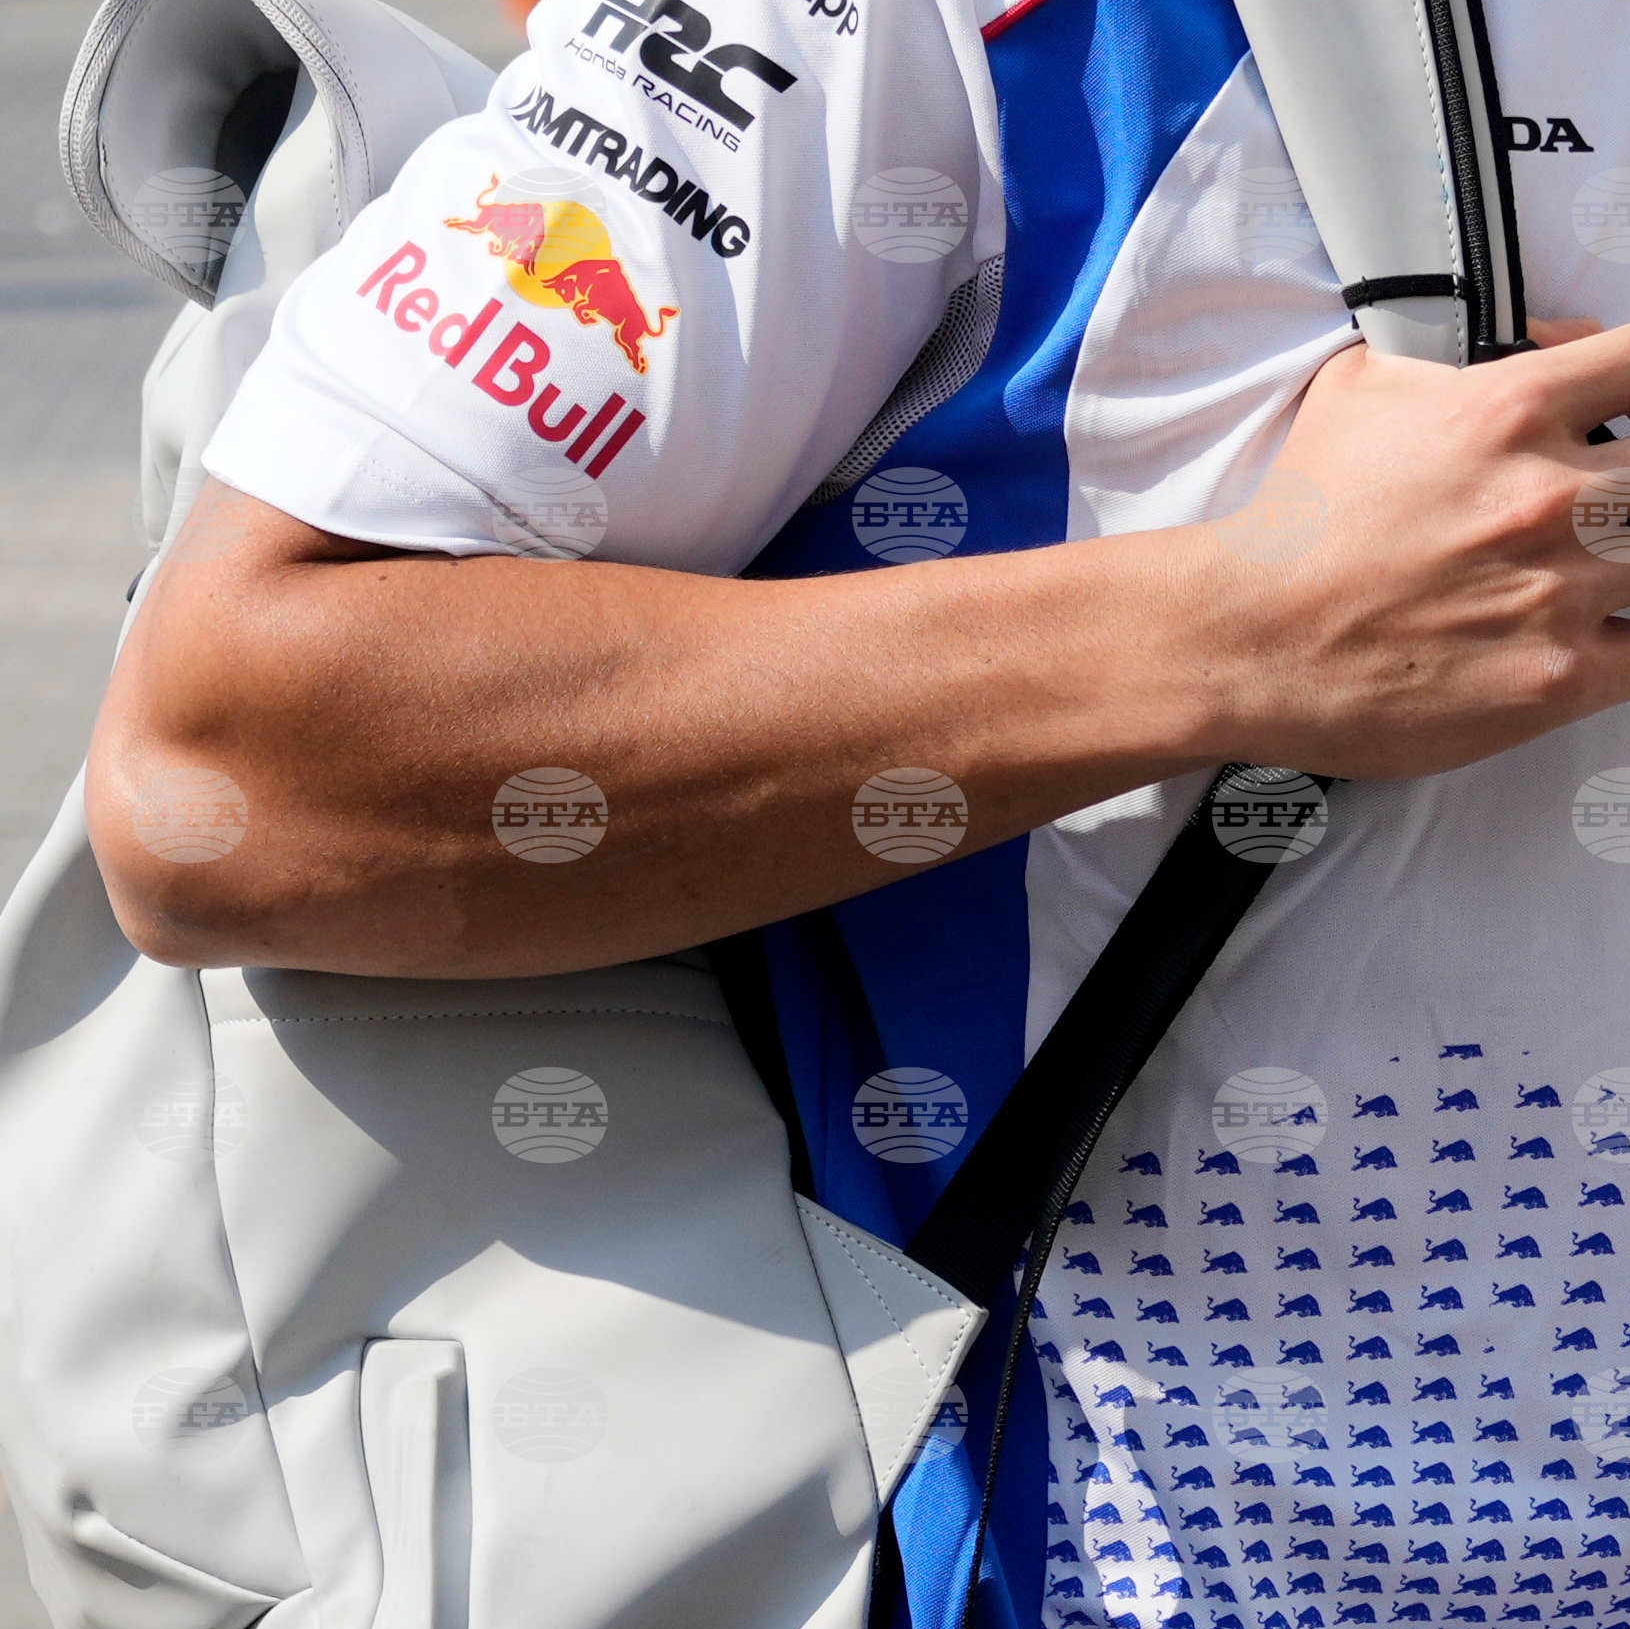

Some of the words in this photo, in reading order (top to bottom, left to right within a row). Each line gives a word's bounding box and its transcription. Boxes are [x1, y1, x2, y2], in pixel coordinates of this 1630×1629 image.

[564, 37, 627, 80] Honda
[632, 74, 742, 153] RACING
[355, 240, 504, 370] Red
[471, 321, 647, 480] Bull
